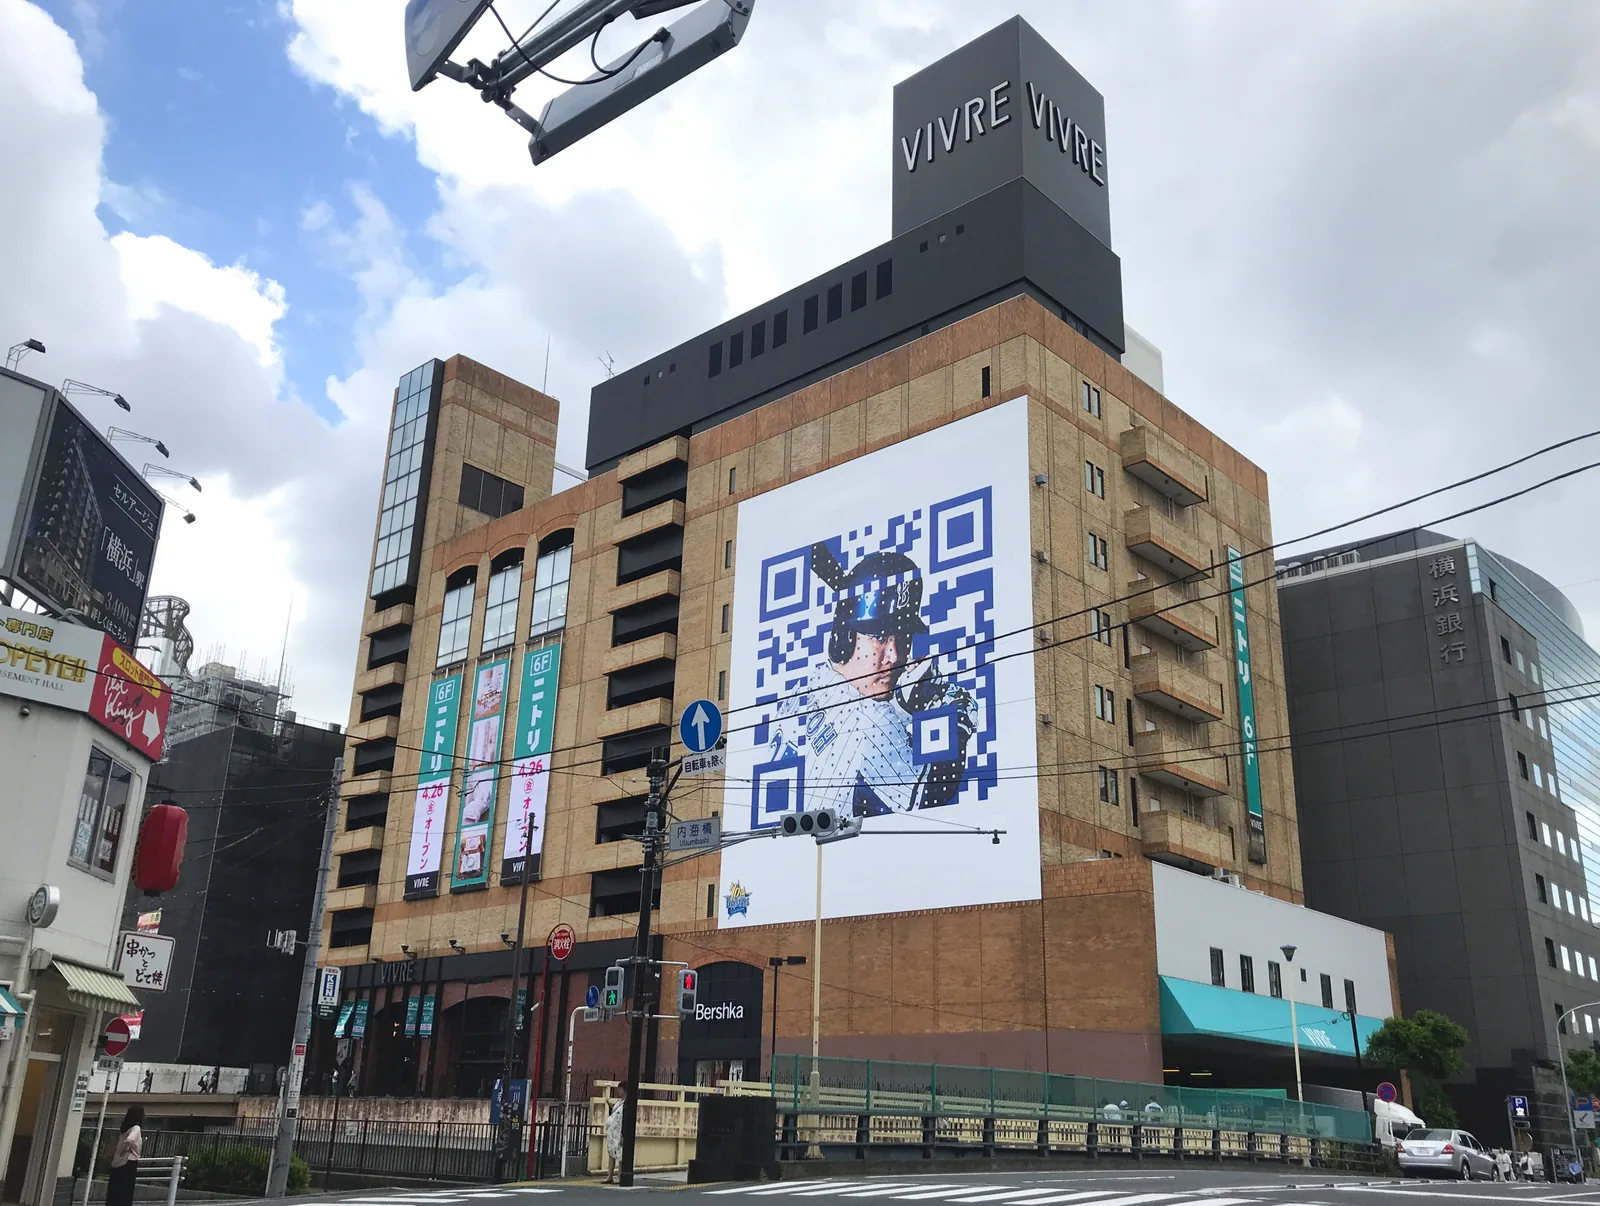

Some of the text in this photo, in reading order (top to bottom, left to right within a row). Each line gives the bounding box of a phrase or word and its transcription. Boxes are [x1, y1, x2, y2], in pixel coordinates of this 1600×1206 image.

[901, 80, 1011, 173] VIVRE
[1026, 81, 1105, 187] VIVRE
[113, 484, 154, 532] セルアージュ
[1429, 555, 1467, 664] 横浜銀行
[90, 606, 128, 643] 詳しくはこちら
[1234, 597, 1250, 685] ニトリ
[533, 653, 549, 673] 6F
[42, 680, 65, 692] HALL
[102, 664, 128, 696] Slot
[437, 682, 453, 700] 6F
[105, 691, 143, 738] King
[527, 677, 544, 753] ニトリ
[431, 706, 447, 776] ニトリ
[1244, 715, 1255, 765] 6F
[518, 759, 543, 778] 4.26
[684, 754, 724, 773] 自転車を除く
[422, 784, 444, 800] 4.26
[677, 822, 712, 838] 内海橋
[413, 876, 430, 889] VIVRE
[553, 938, 570, 950] 消火栓
[142, 959, 149, 968] と
[381, 960, 415, 983] VIVRE
[135, 967, 163, 986] どて焼
[325, 974, 335, 997] KEN
[695, 1002, 744, 1021] Bershka
[1301, 1027, 1337, 1049] VIVRE
[1515, 1098, 1523, 1107] P
[1576, 1097, 1589, 1109] P
